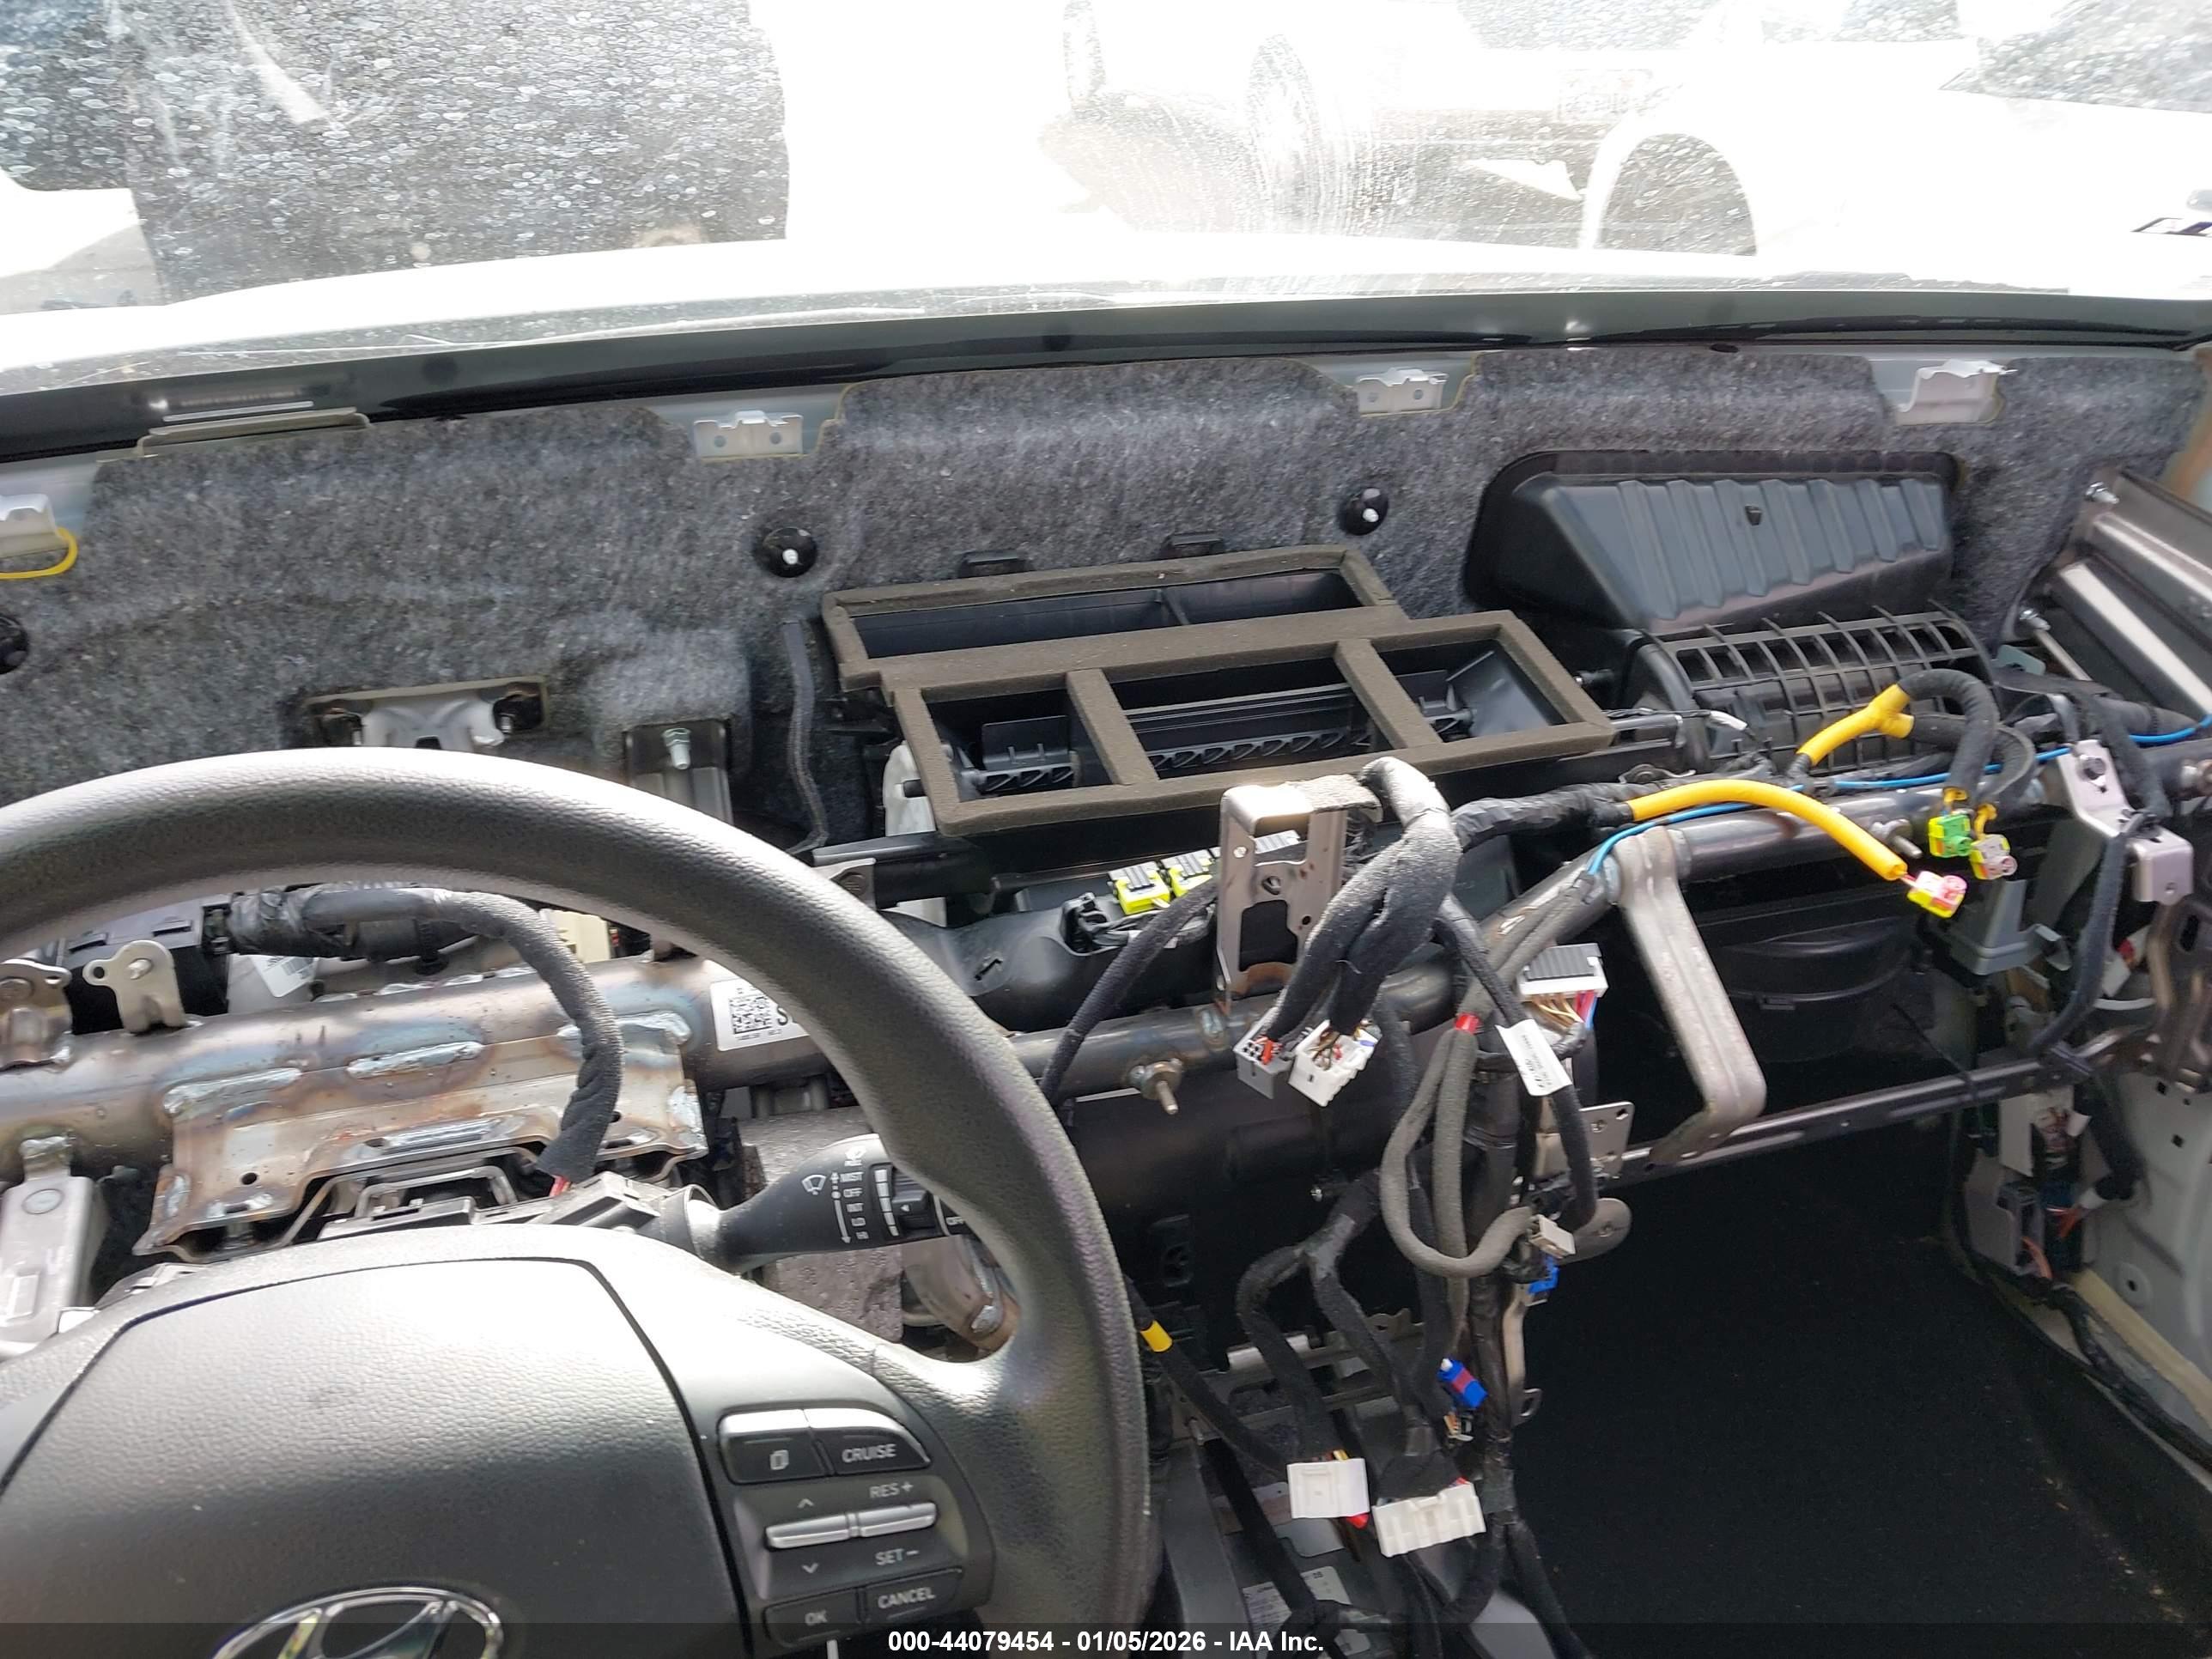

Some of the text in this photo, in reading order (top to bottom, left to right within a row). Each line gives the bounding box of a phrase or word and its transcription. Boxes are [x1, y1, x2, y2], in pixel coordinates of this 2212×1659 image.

[842, 1443, 896, 1463] CRUISE
[878, 1587, 935, 1609] CANCEL
[805, 1610, 828, 1626] OK
